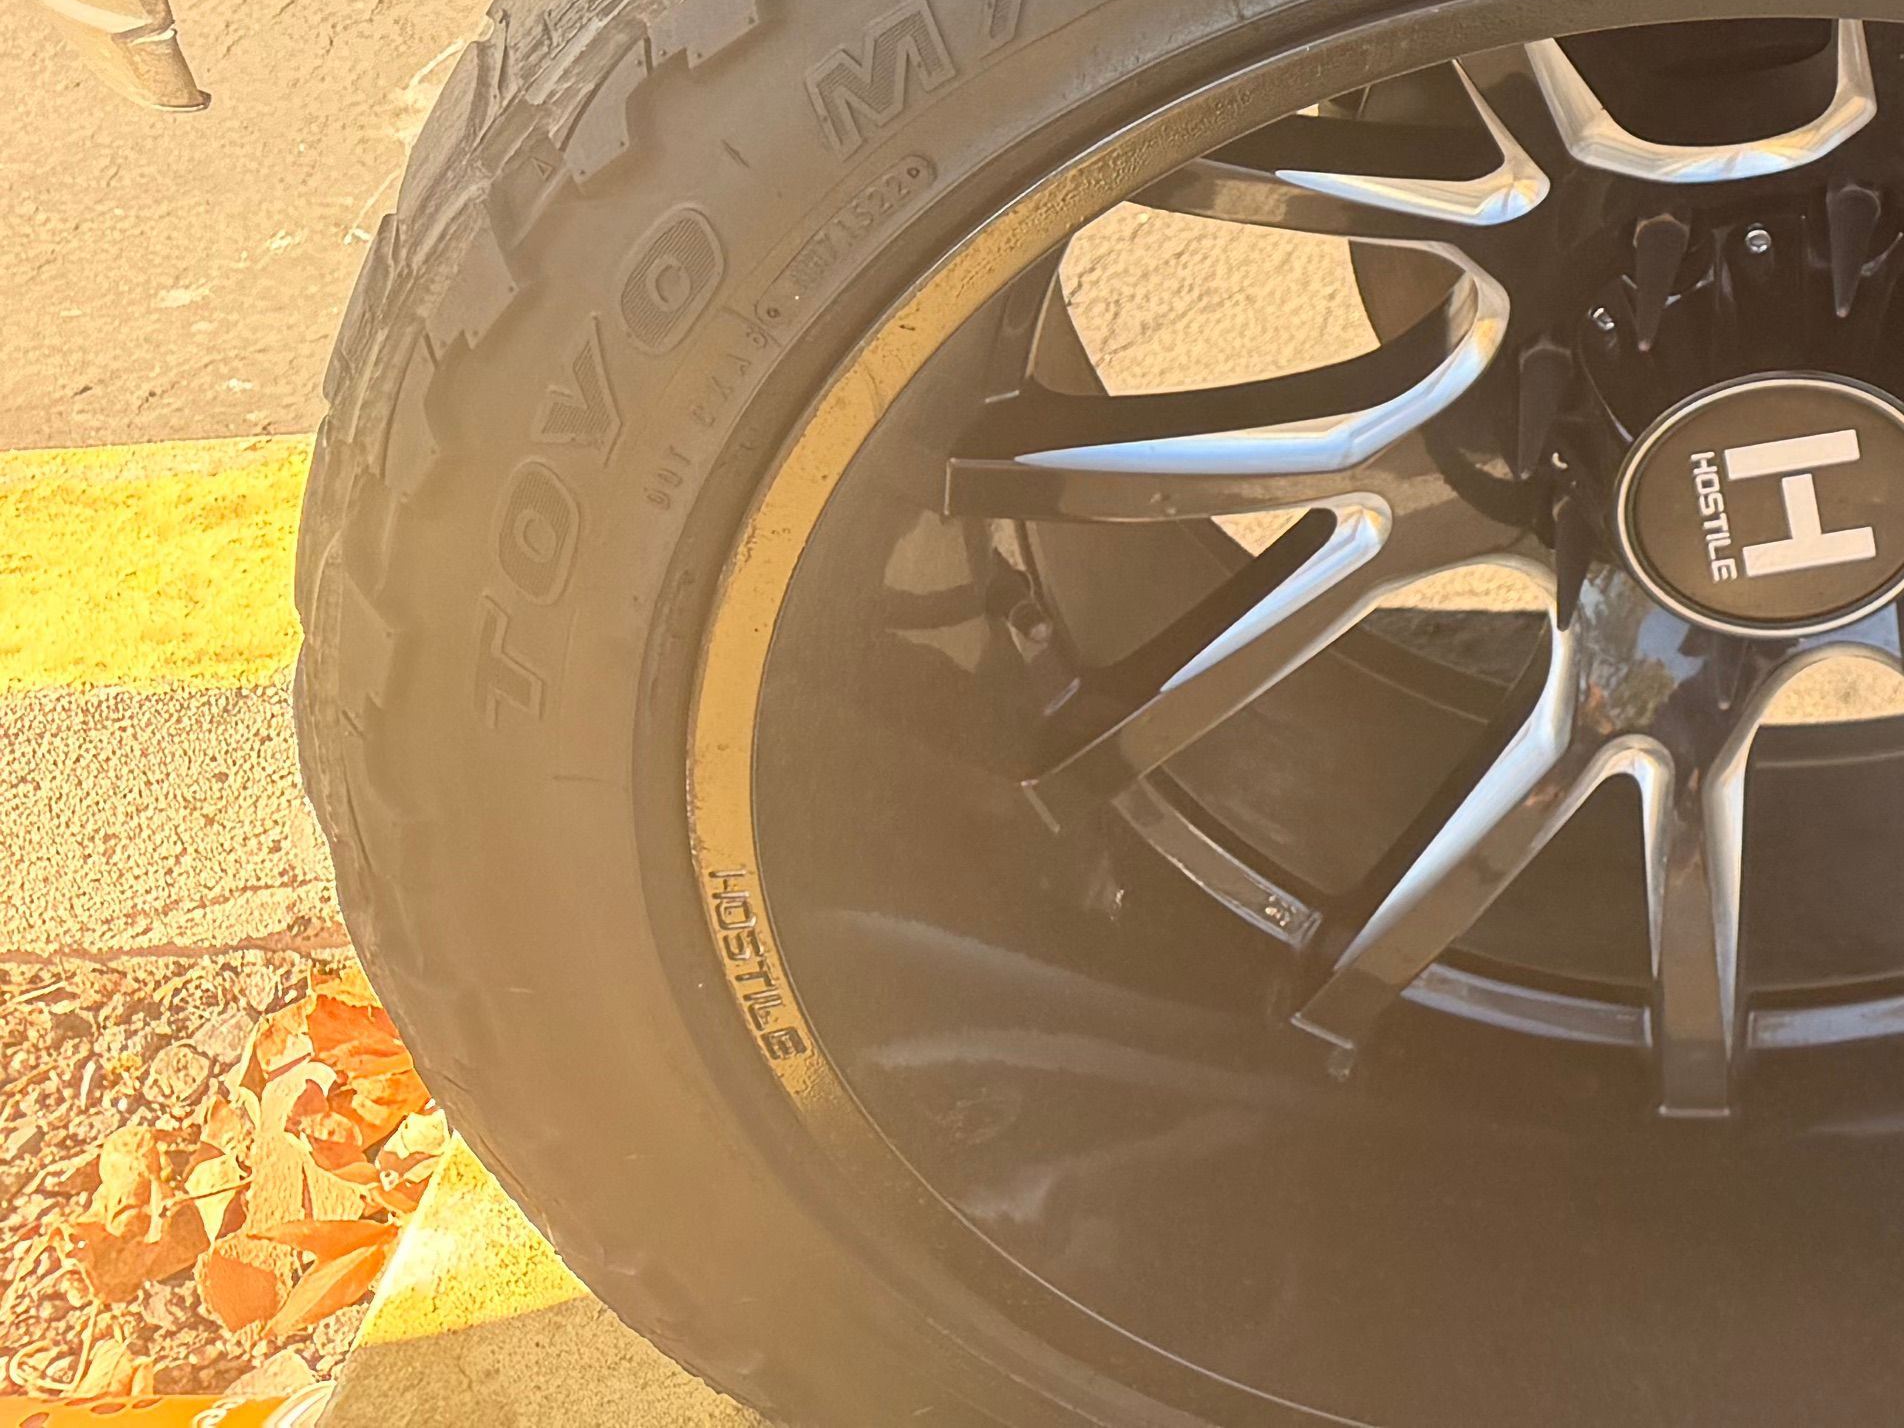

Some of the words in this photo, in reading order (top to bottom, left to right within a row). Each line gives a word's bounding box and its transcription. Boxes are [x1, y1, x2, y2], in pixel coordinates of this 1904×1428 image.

[471, 203, 727, 731] TOYO
[1690, 451, 1738, 584] HOSTILE
[1723, 428, 1877, 578] H
[707, 866, 809, 1061] HOSTILE
